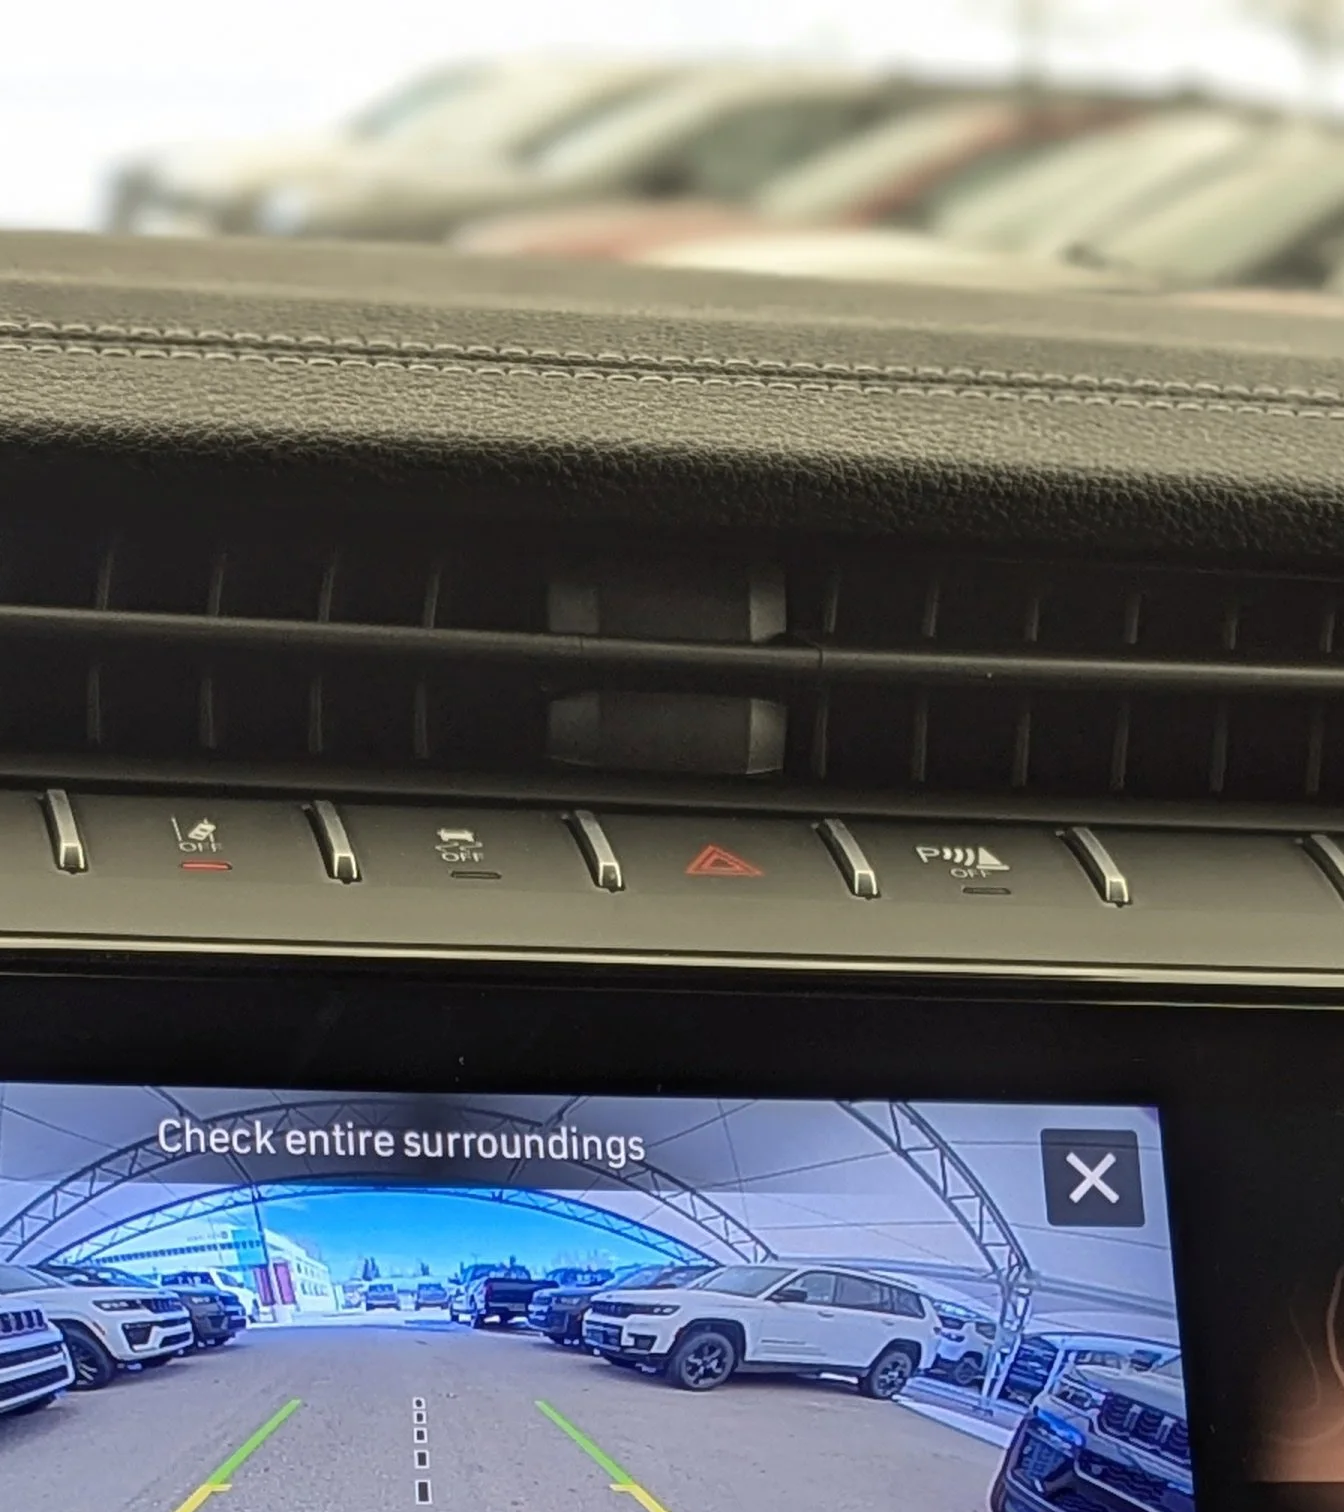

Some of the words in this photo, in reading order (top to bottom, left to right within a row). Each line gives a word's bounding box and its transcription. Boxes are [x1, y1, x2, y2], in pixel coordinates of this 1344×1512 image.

[178, 842, 223, 853] OFF
[441, 852, 484, 862] OFF
[950, 868, 992, 878] OFF
[157, 1118, 274, 1156] Check
[285, 1123, 395, 1158] entire
[403, 1127, 646, 1170] surroundings
